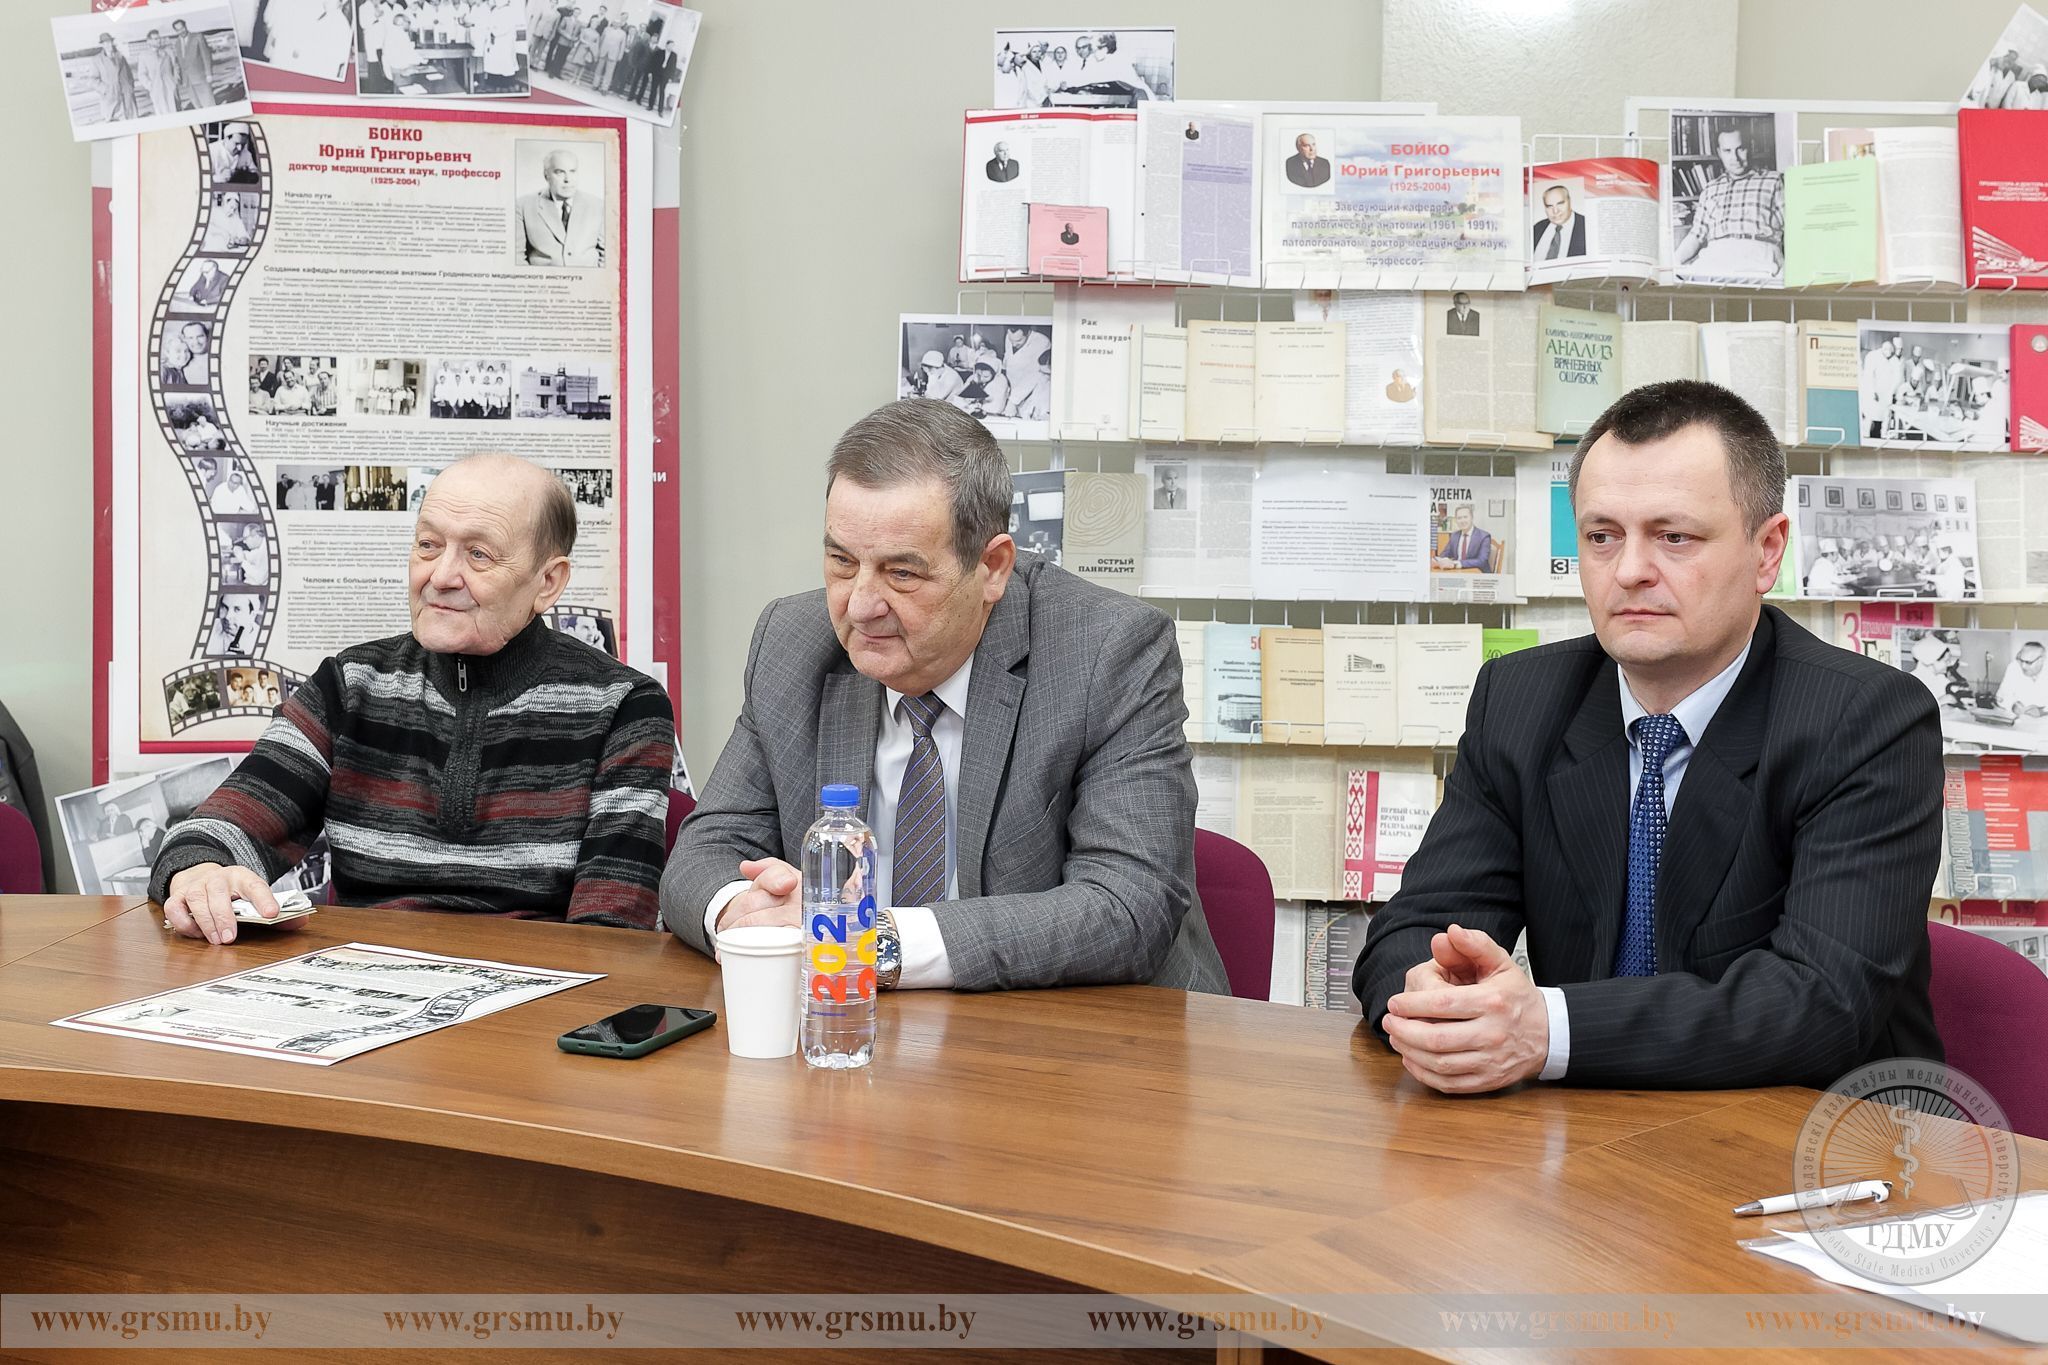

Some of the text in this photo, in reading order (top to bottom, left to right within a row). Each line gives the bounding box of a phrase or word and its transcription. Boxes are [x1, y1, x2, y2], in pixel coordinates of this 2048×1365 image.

[368, 124, 423, 142] БОЙКО
[319, 144, 472, 164] Юрий Григорьевич
[1390, 141, 1450, 156] БОЙКО
[288, 163, 501, 179] доктор медицинских наук, профессор
[1340, 164, 1500, 180] Юрий Григорьевич
[370, 177, 421, 187] (1925-2004)
[1389, 182, 1451, 192] (1925-2004)
[284, 191, 332, 201] Начало пути
[1334, 200, 1400, 213] Заведующий
[1376, 221, 1426, 229] анатомии
[1370, 239, 1405, 248] доктор
[264, 265, 300, 273] Создание
[302, 267, 338, 275] кафедры
[339, 268, 399, 276] патологической
[438, 270, 489, 279] Гродненского
[491, 273, 544, 281] медицинского
[1081, 318, 1098, 326] Рак
[1546, 338, 1614, 360] АНАЛИЗ
[1554, 357, 1603, 373] ВРАЧЕБНЫХ
[1558, 370, 1599, 385] ОШИБОК
[265, 420, 300, 428] Научные
[1430, 487, 1472, 501] УДЕНТА
[1098, 557, 1134, 565] ОСТРЫЙ
[1553, 559, 1568, 574] 3
[1078, 565, 1135, 573] ПАНКРЕАТИТ
[303, 576, 334, 584] Человек
[343, 576, 377, 584] большой
[379, 577, 403, 585] буквы
[1380, 823, 1423, 831] РЕСПУБЛИКИ
[812, 913, 847, 1004] 202
